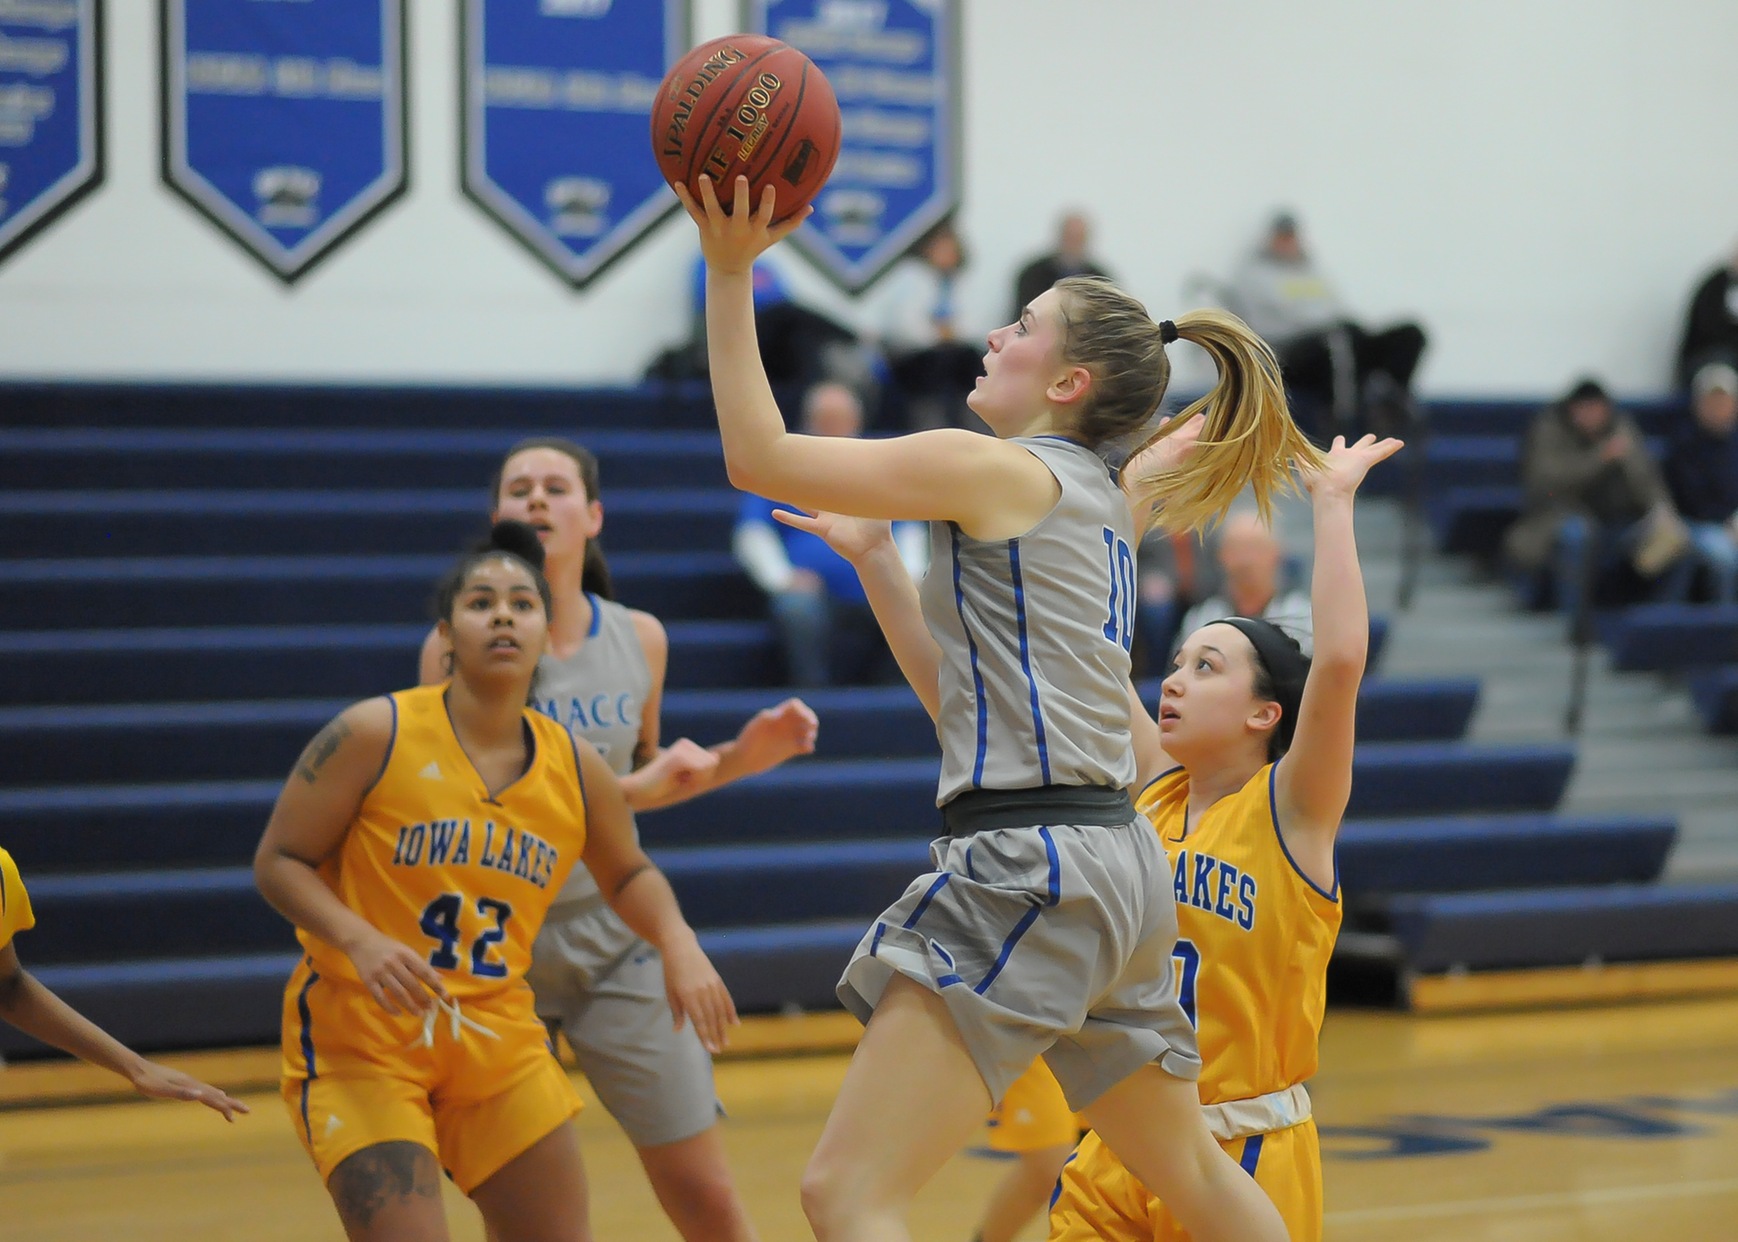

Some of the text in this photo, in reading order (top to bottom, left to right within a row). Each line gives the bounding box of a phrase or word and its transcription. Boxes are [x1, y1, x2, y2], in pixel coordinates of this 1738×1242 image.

[664, 46, 749, 165] SPALDING
[737, 112, 770, 162] LEGACY
[1102, 523, 1138, 656] 10
[393, 817, 560, 891] IOWA LAKES
[1173, 849, 1258, 933] AKES
[418, 891, 513, 979] 42
